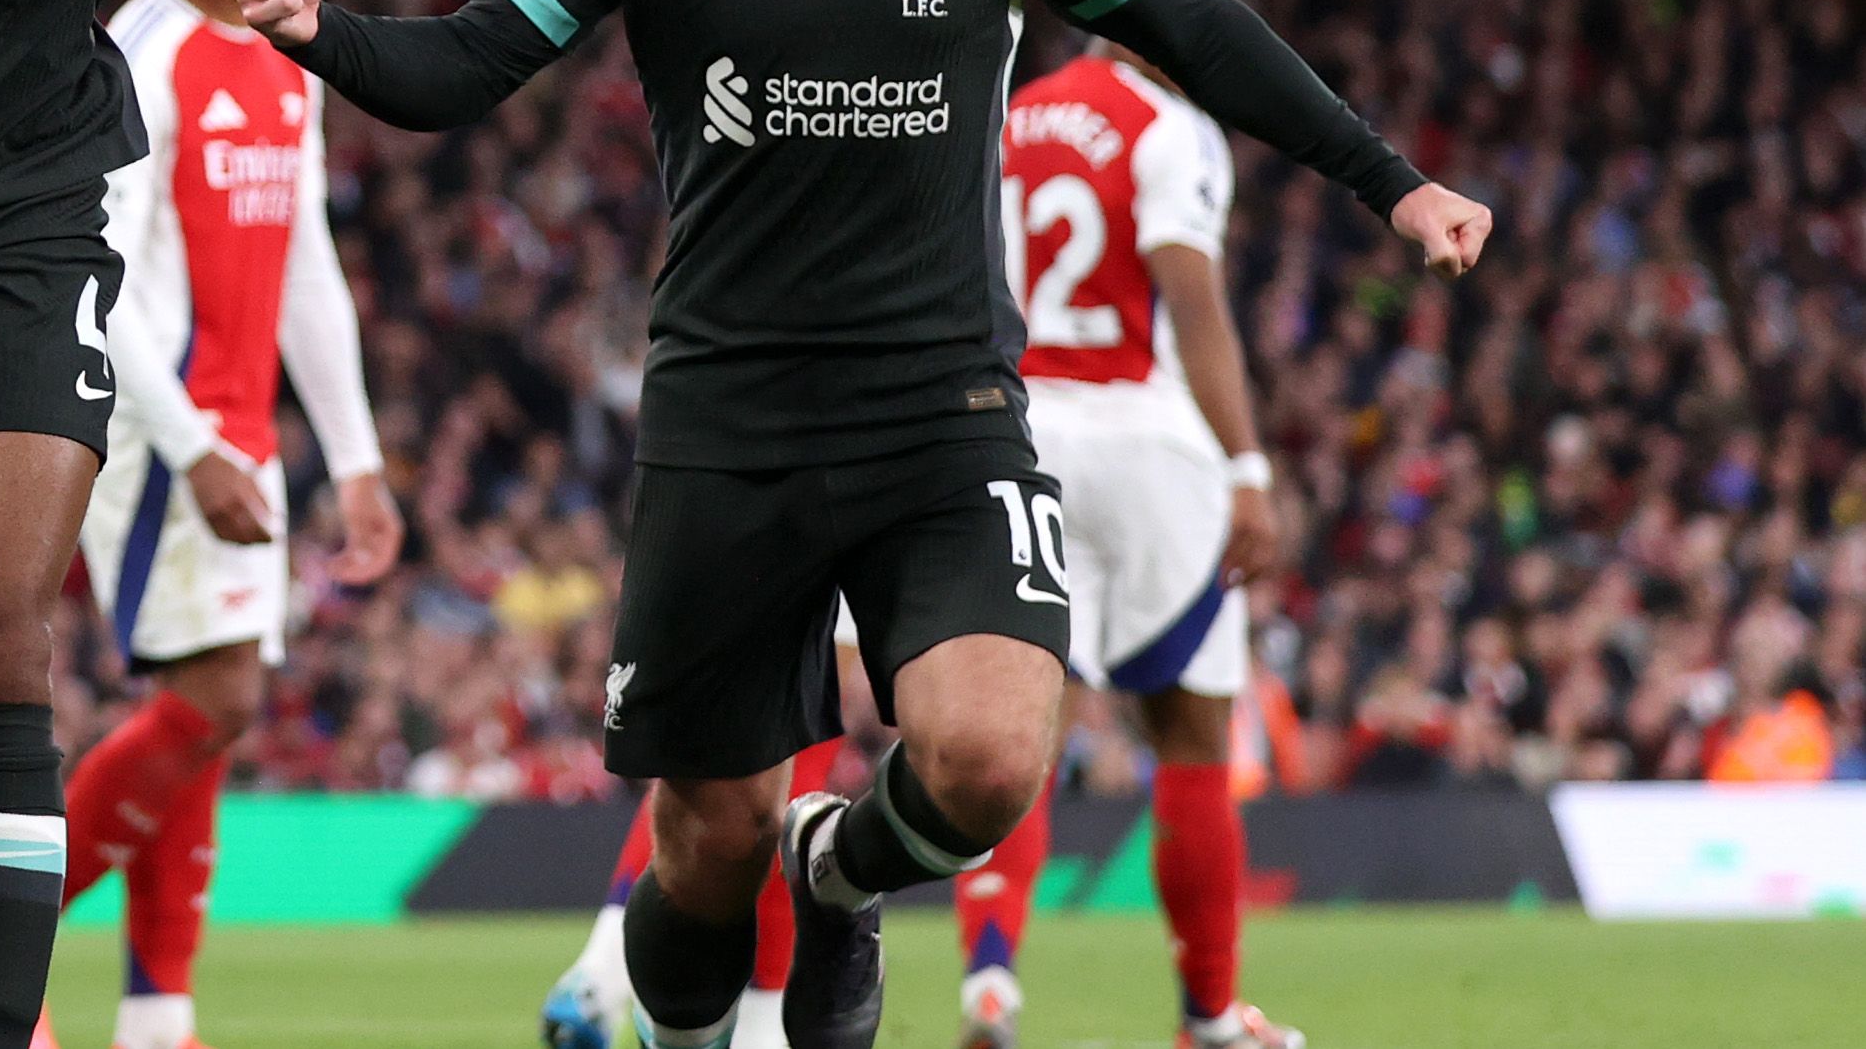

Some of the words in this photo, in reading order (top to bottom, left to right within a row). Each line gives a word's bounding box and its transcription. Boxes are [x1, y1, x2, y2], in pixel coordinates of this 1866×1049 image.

[765, 72, 944, 107] standard
[765, 102, 950, 139] chartered
[1001, 172, 1124, 348] 12
[986, 480, 1070, 595] 10
